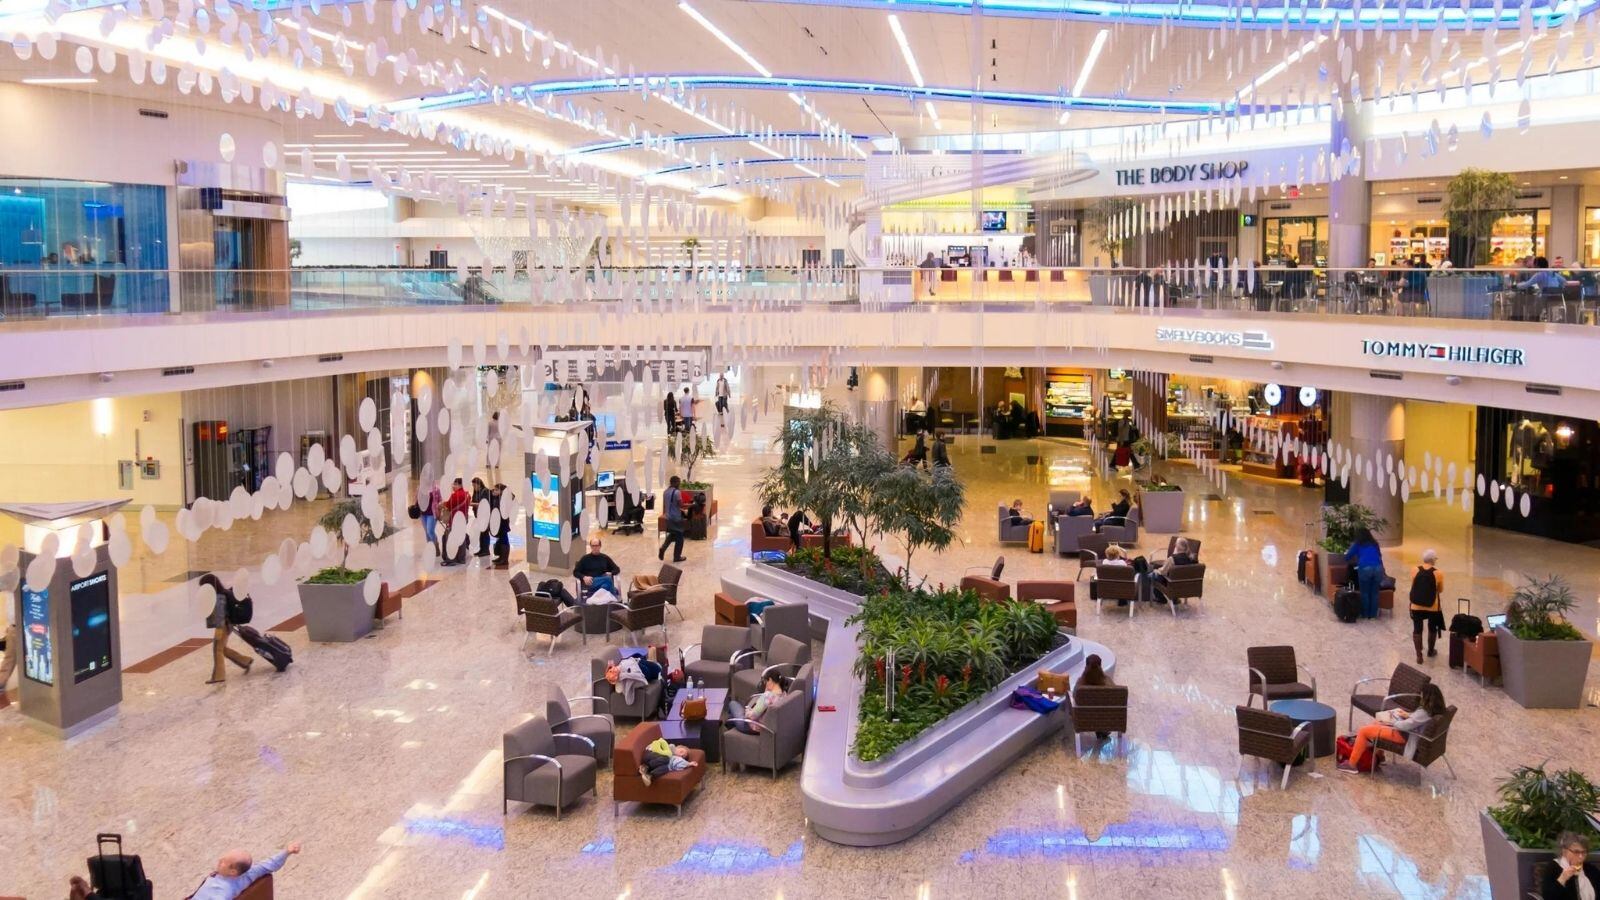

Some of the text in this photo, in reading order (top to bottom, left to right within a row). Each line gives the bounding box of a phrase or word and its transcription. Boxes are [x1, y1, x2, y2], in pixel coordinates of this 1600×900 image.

[1115, 160, 1249, 186] THE BODY SHOP
[1361, 340, 1524, 365] TOMMY HILFIGER
